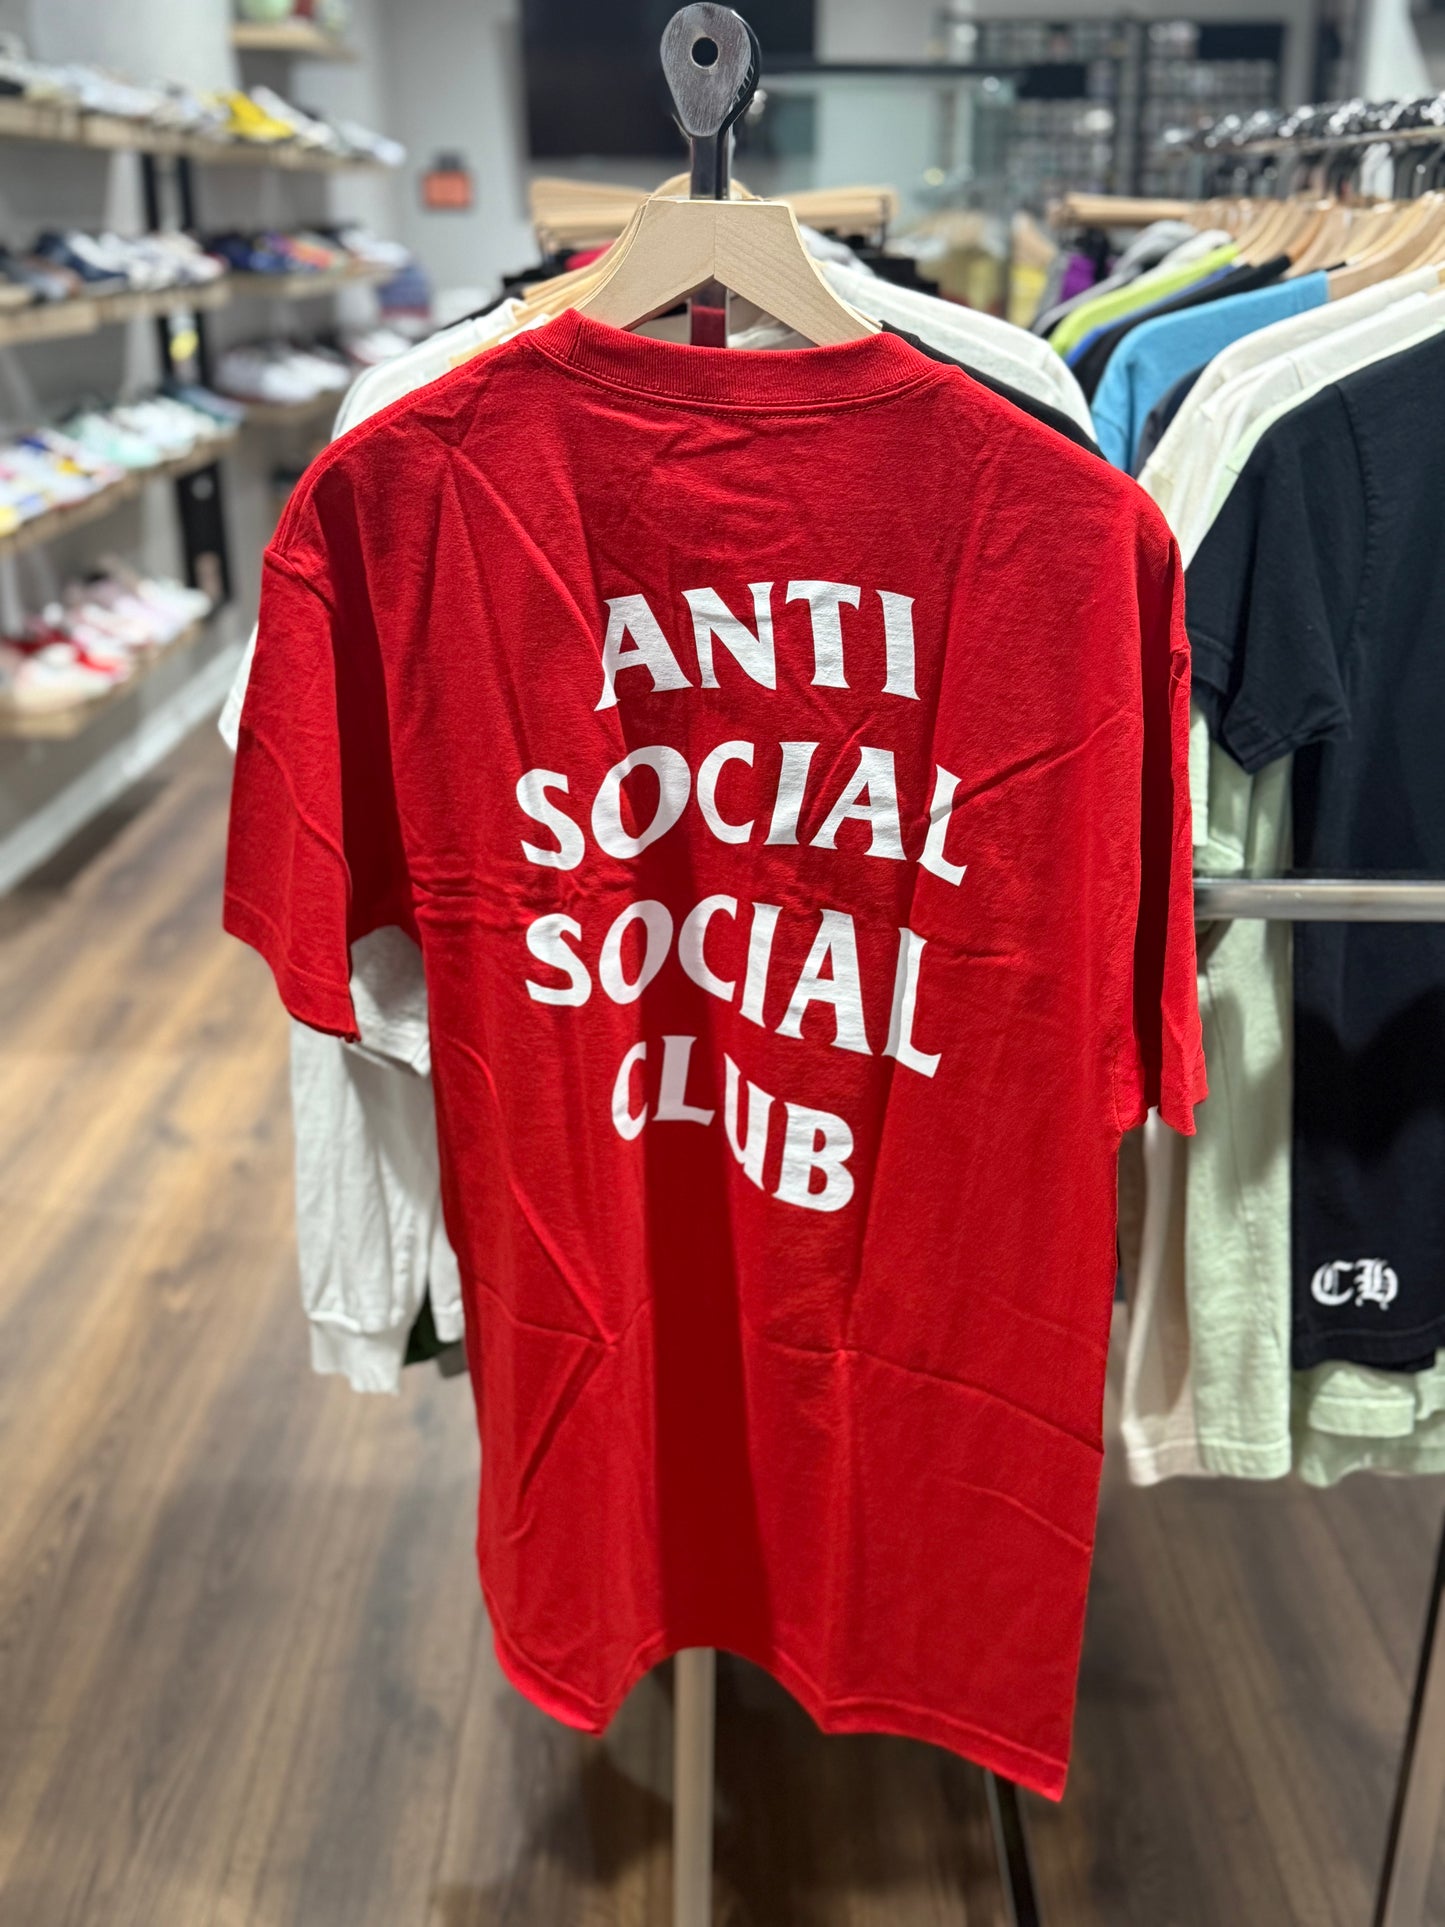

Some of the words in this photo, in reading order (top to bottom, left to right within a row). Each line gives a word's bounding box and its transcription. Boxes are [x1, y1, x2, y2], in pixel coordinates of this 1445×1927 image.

[593, 579, 921, 712] ANTI
[515, 740, 968, 887] SOCIAL
[525, 893, 942, 1078] SOCIAL
[611, 1035, 855, 1213] CLUB
